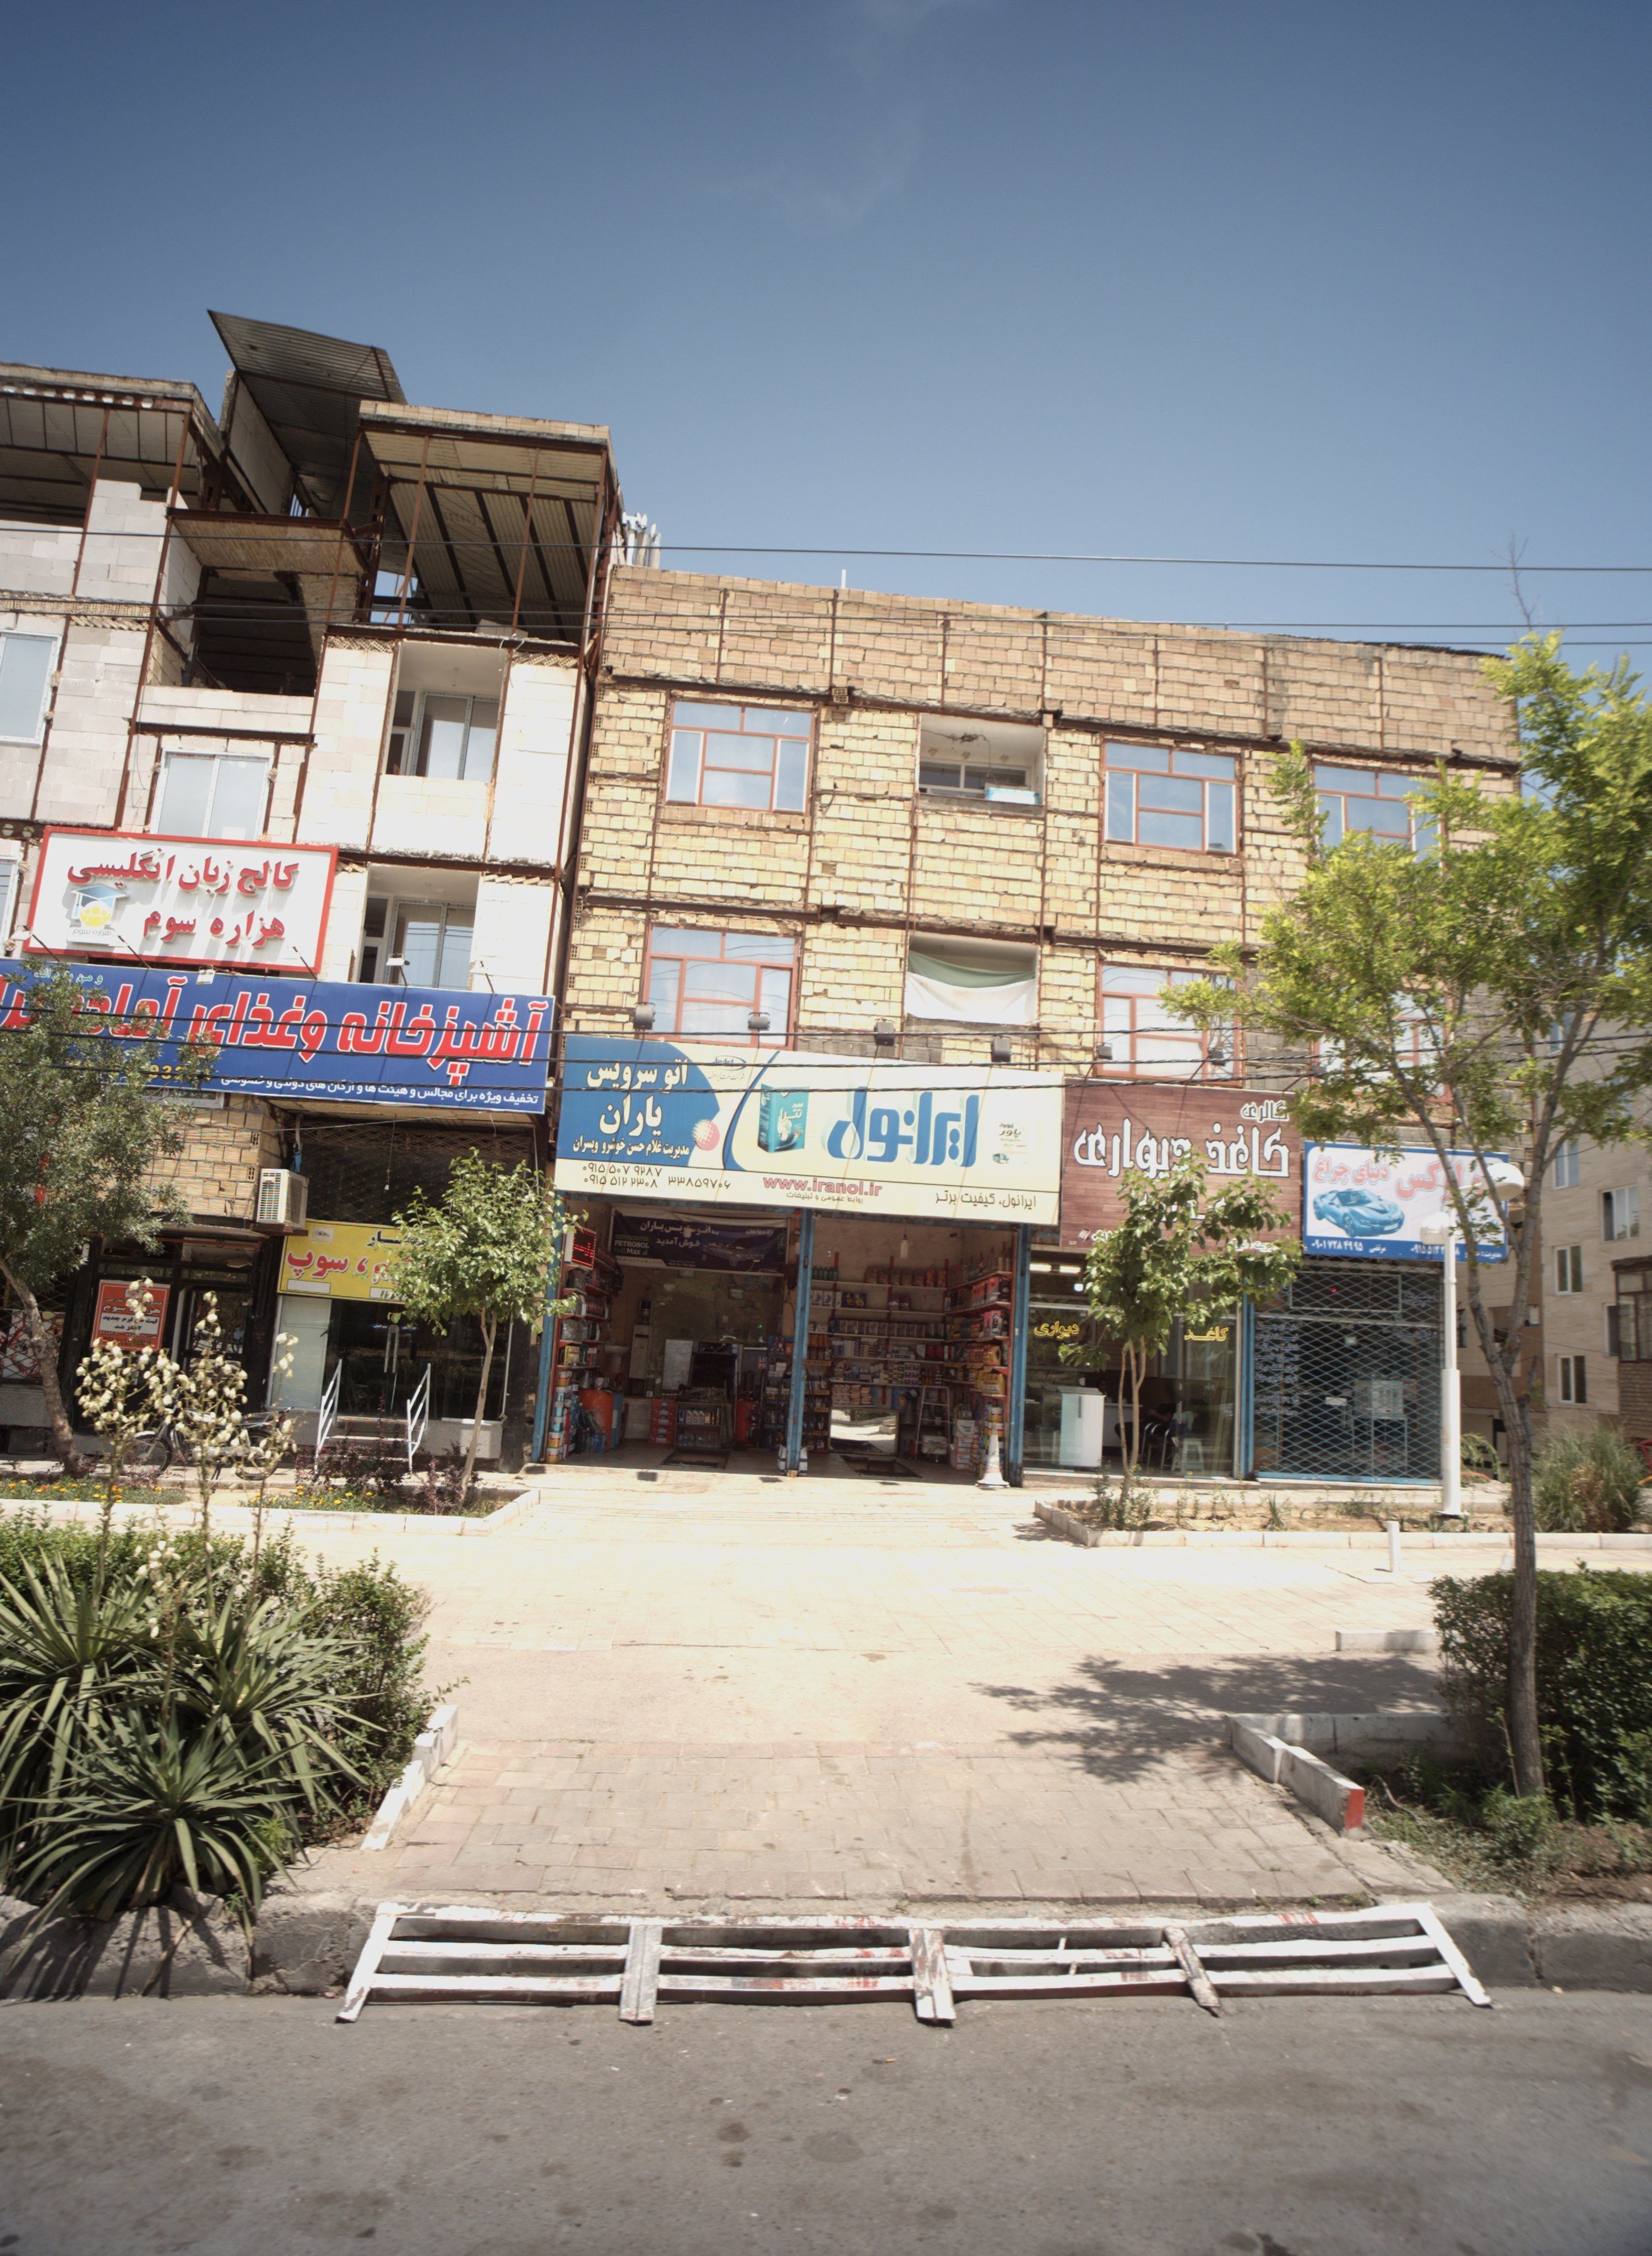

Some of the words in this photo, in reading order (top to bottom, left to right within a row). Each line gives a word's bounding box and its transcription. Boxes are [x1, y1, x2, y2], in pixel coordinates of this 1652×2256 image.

[67, 848, 176, 888] انگلیسی
[178, 856, 233, 896] زبان
[237, 860, 299, 896] کالج
[144, 910, 197, 944] سوم
[210, 910, 285, 947] هزاره
[336, 996, 549, 1087] آشپزخانه
[586, 1062, 657, 1090] سرویس
[665, 1058, 688, 1094] اتو
[357, 1084, 363, 1094] و
[365, 1083, 376, 1094] ها
[410, 1089, 416, 1098] و
[417, 1087, 453, 1100] مجالس
[455, 1088, 478, 1103] برای
[480, 1092, 501, 1104] ویژه
[503, 1092, 539, 1105] تخفیف
[599, 1093, 662, 1137] یاران
[1241, 1100, 1290, 1122] گالری
[827, 1086, 980, 1168] ایرانول
[602, 1137, 626, 1155] خوشرو
[627, 1142, 645, 1156] حسن
[646, 1139, 662, 1157] غلام
[663, 1144, 690, 1159] مدیریت
[1206, 1122, 1290, 1178] کاغذ
[583, 1163, 605, 1173] ۰۹۱۵
[1314, 1156, 1350, 1184] چراغ
[1352, 1159, 1390, 1184] دنیای
[584, 1174, 607, 1185] ۰۹۱۵
[763, 1176, 883, 1197] www.iranol.ir
[786, 1191, 813, 1200] تبلیغات
[821, 1194, 845, 1203] عمومی
[847, 1195, 863, 1204] روابط
[936, 1191, 957, 1205] برتر
[961, 1192, 995, 1206] کیفیت
[640, 1221, 664, 1233] یاران
[614, 1240, 650, 1249] PETRONOL
[656, 1237, 677, 1246] آمدید
[679, 1239, 700, 1248] خوش
[287, 1251, 348, 1277] سوپ
[1034, 1320, 1080, 1340] دیواری
